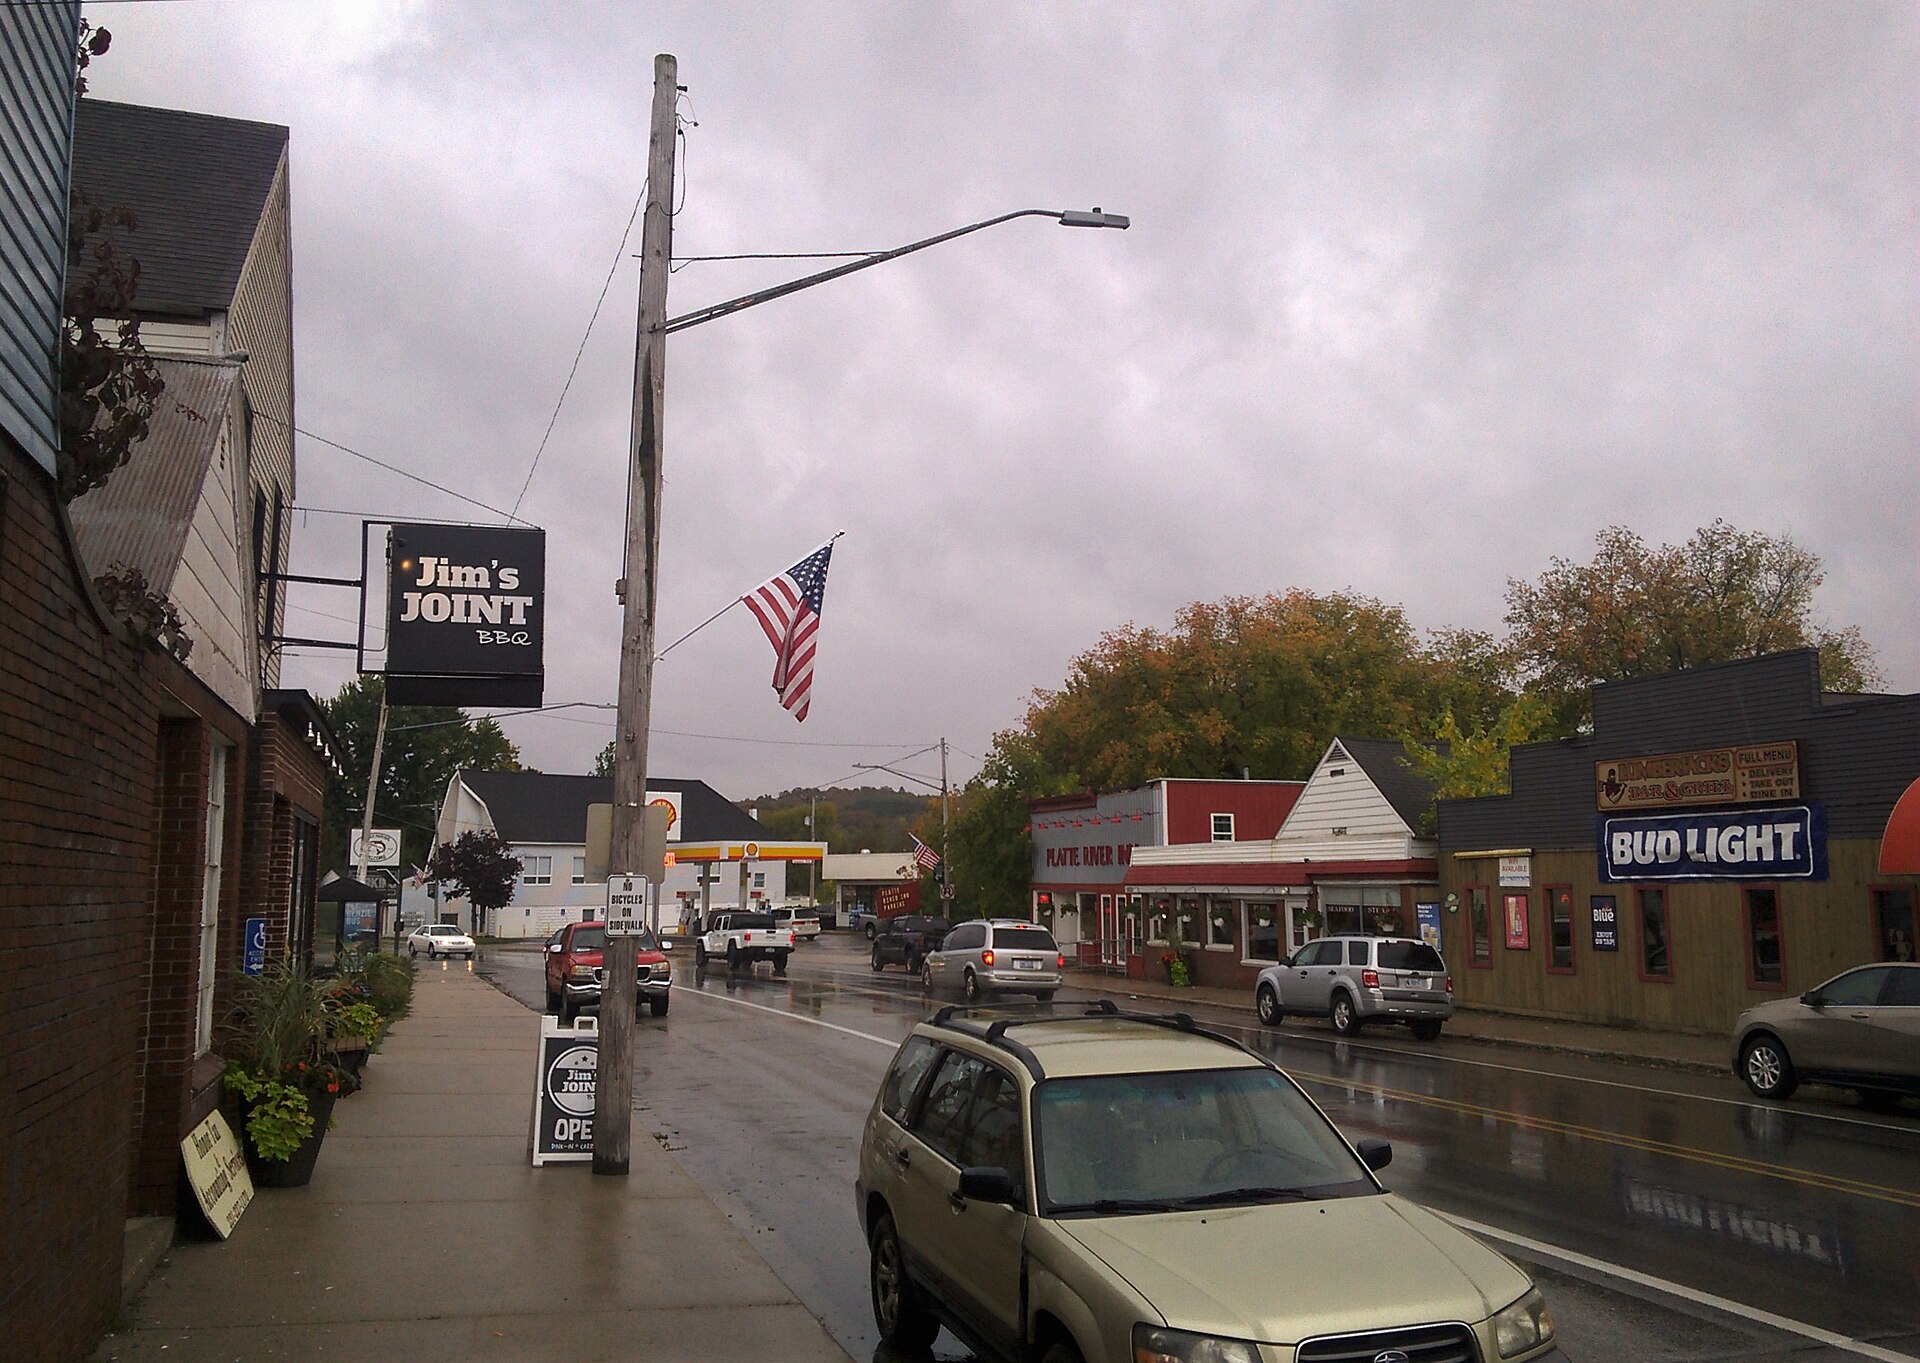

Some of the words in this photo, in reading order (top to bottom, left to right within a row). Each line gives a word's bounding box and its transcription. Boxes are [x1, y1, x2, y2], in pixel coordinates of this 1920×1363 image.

[416, 557, 520, 590] Jim's
[400, 592, 533, 625] JOINT
[475, 629, 532, 646] BBQ
[1740, 751, 1761, 763] FULL
[1763, 749, 1792, 761] MENU
[1749, 768, 1793, 778] DELIVERY
[1750, 779, 1772, 788] TAKE
[1775, 777, 1794, 786] OUT
[1751, 790, 1777, 798] DINE
[1780, 788, 1793, 796] IN
[1612, 830, 1681, 865] BUD
[1686, 823, 1801, 863] LIGHT
[1083, 845, 1113, 866] RIVER
[623, 882, 633, 891] NO
[611, 895, 643, 904] BICYCLES
[622, 907, 632, 917] ON
[1593, 909, 1615, 922] Blue
[609, 921, 643, 930] SIDEWALK
[562, 1081, 596, 1092] JOIN
[554, 1118, 593, 1141] OPE
